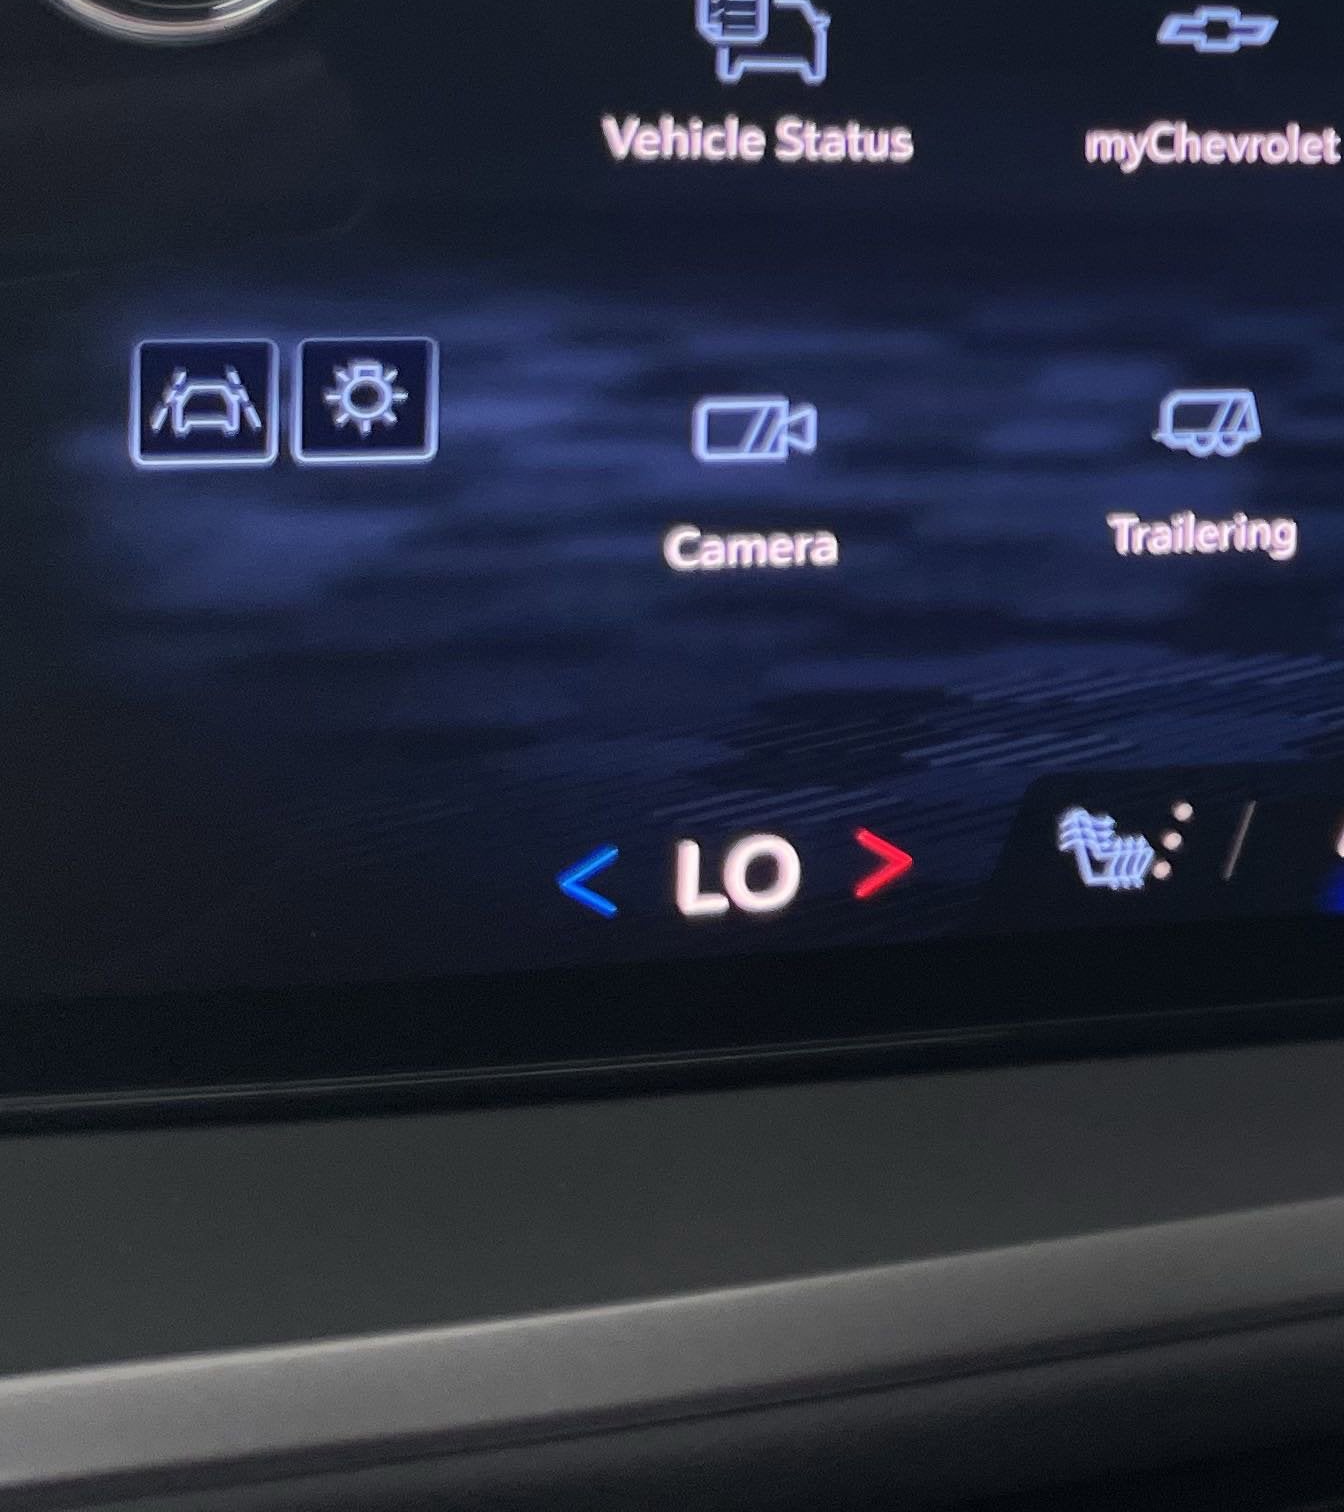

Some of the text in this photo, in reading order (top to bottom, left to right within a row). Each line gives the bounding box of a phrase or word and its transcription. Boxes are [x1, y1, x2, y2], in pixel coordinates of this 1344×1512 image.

[601, 115, 915, 163] Vehicle Status
[1084, 120, 1342, 174] myChevrolet
[663, 525, 840, 572] Camera
[1106, 510, 1298, 561] Trailering
[675, 833, 801, 917] LO
